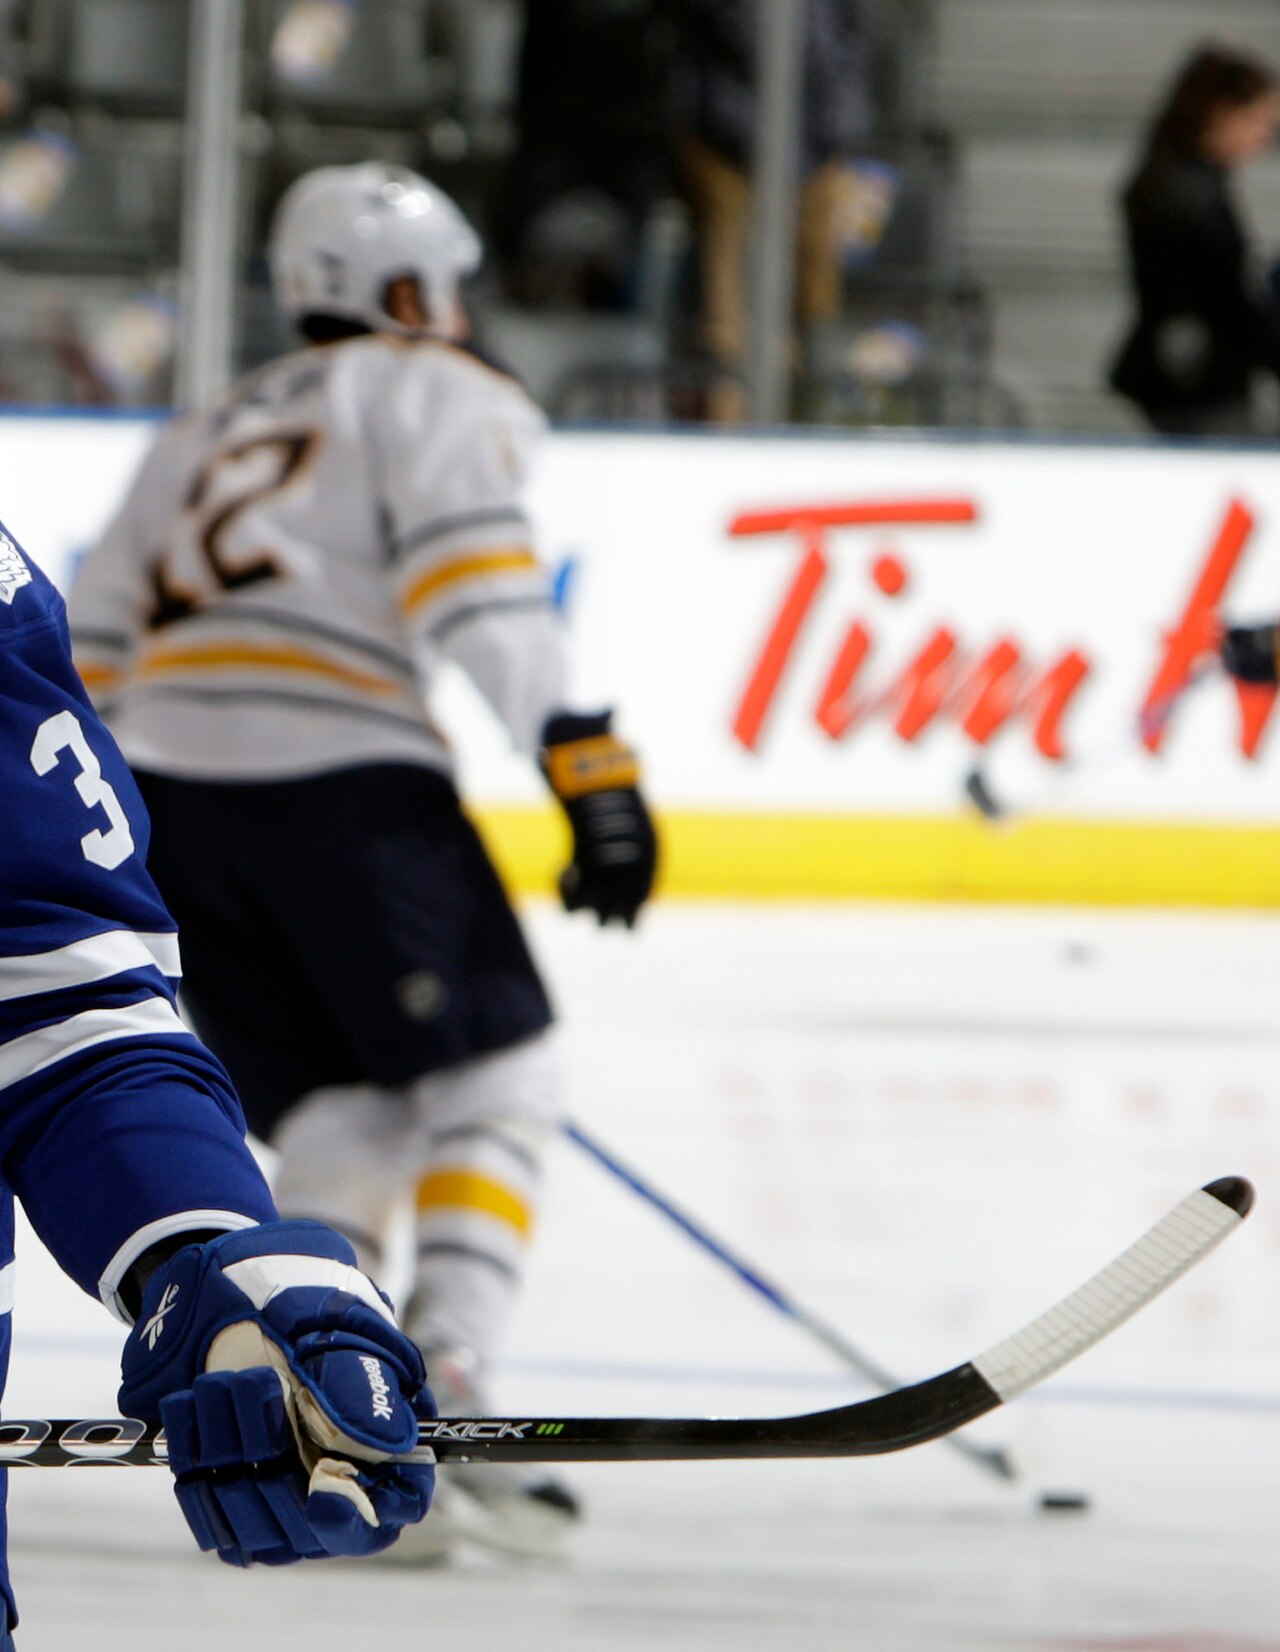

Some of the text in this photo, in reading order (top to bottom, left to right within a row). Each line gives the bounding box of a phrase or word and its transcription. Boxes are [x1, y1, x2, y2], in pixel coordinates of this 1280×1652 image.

[728, 500, 1089, 762] Tim
[30, 709, 135, 871] 3
[358, 1355, 394, 1421] Reebok
